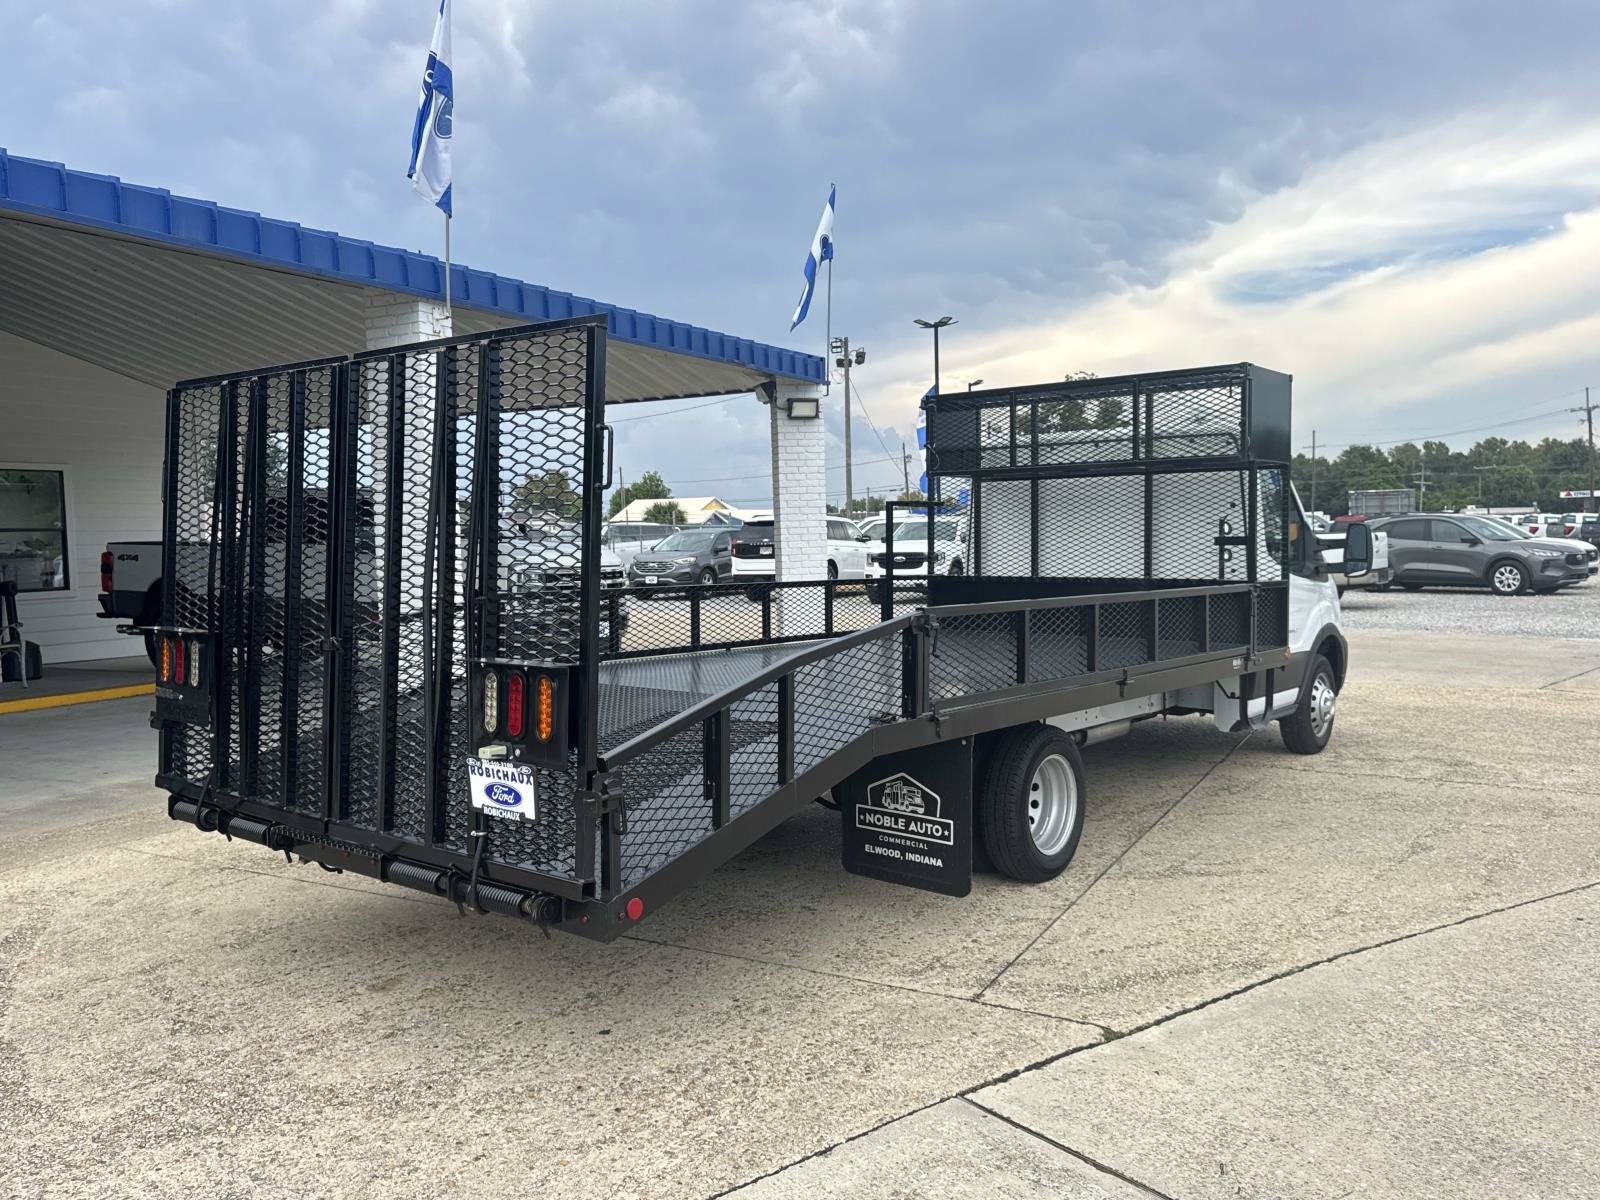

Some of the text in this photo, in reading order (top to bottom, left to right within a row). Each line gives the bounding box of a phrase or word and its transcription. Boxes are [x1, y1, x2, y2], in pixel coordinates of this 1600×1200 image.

[470, 765, 533, 785] ROBICHAUX
[491, 784, 515, 803] Ford
[483, 805, 521, 821] ROBICHAUX
[865, 812, 943, 836] NOBLE AUTO
[878, 834, 929, 850] COMMERCIAL
[864, 844, 944, 868] ELWOOD, INDIANA
